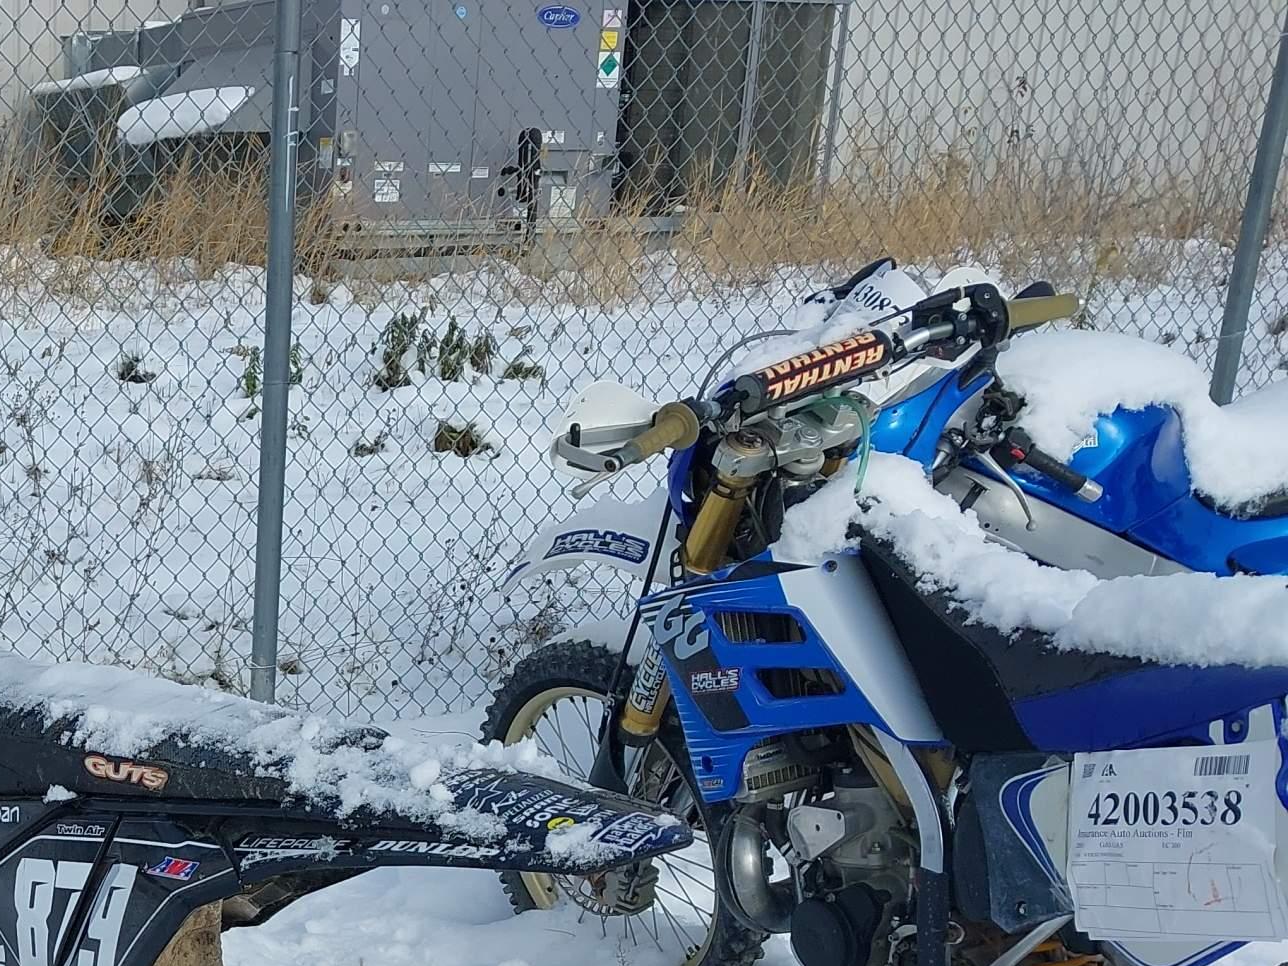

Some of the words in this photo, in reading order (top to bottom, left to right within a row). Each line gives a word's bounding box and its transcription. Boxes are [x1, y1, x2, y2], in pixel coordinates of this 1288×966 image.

[768, 345, 885, 400] RENTHAL
[691, 669, 739, 681] HALL'S
[691, 678, 739, 690] CYCLES
[84, 755, 169, 788] GUTS
[504, 789, 555, 821] PECIALIZED
[1087, 790, 1243, 826] 42003538
[57, 824, 84, 835] Twin
[84, 825, 105, 836] Air
[1110, 829, 1131, 838] Auto
[1133, 828, 1169, 838] Auctions
